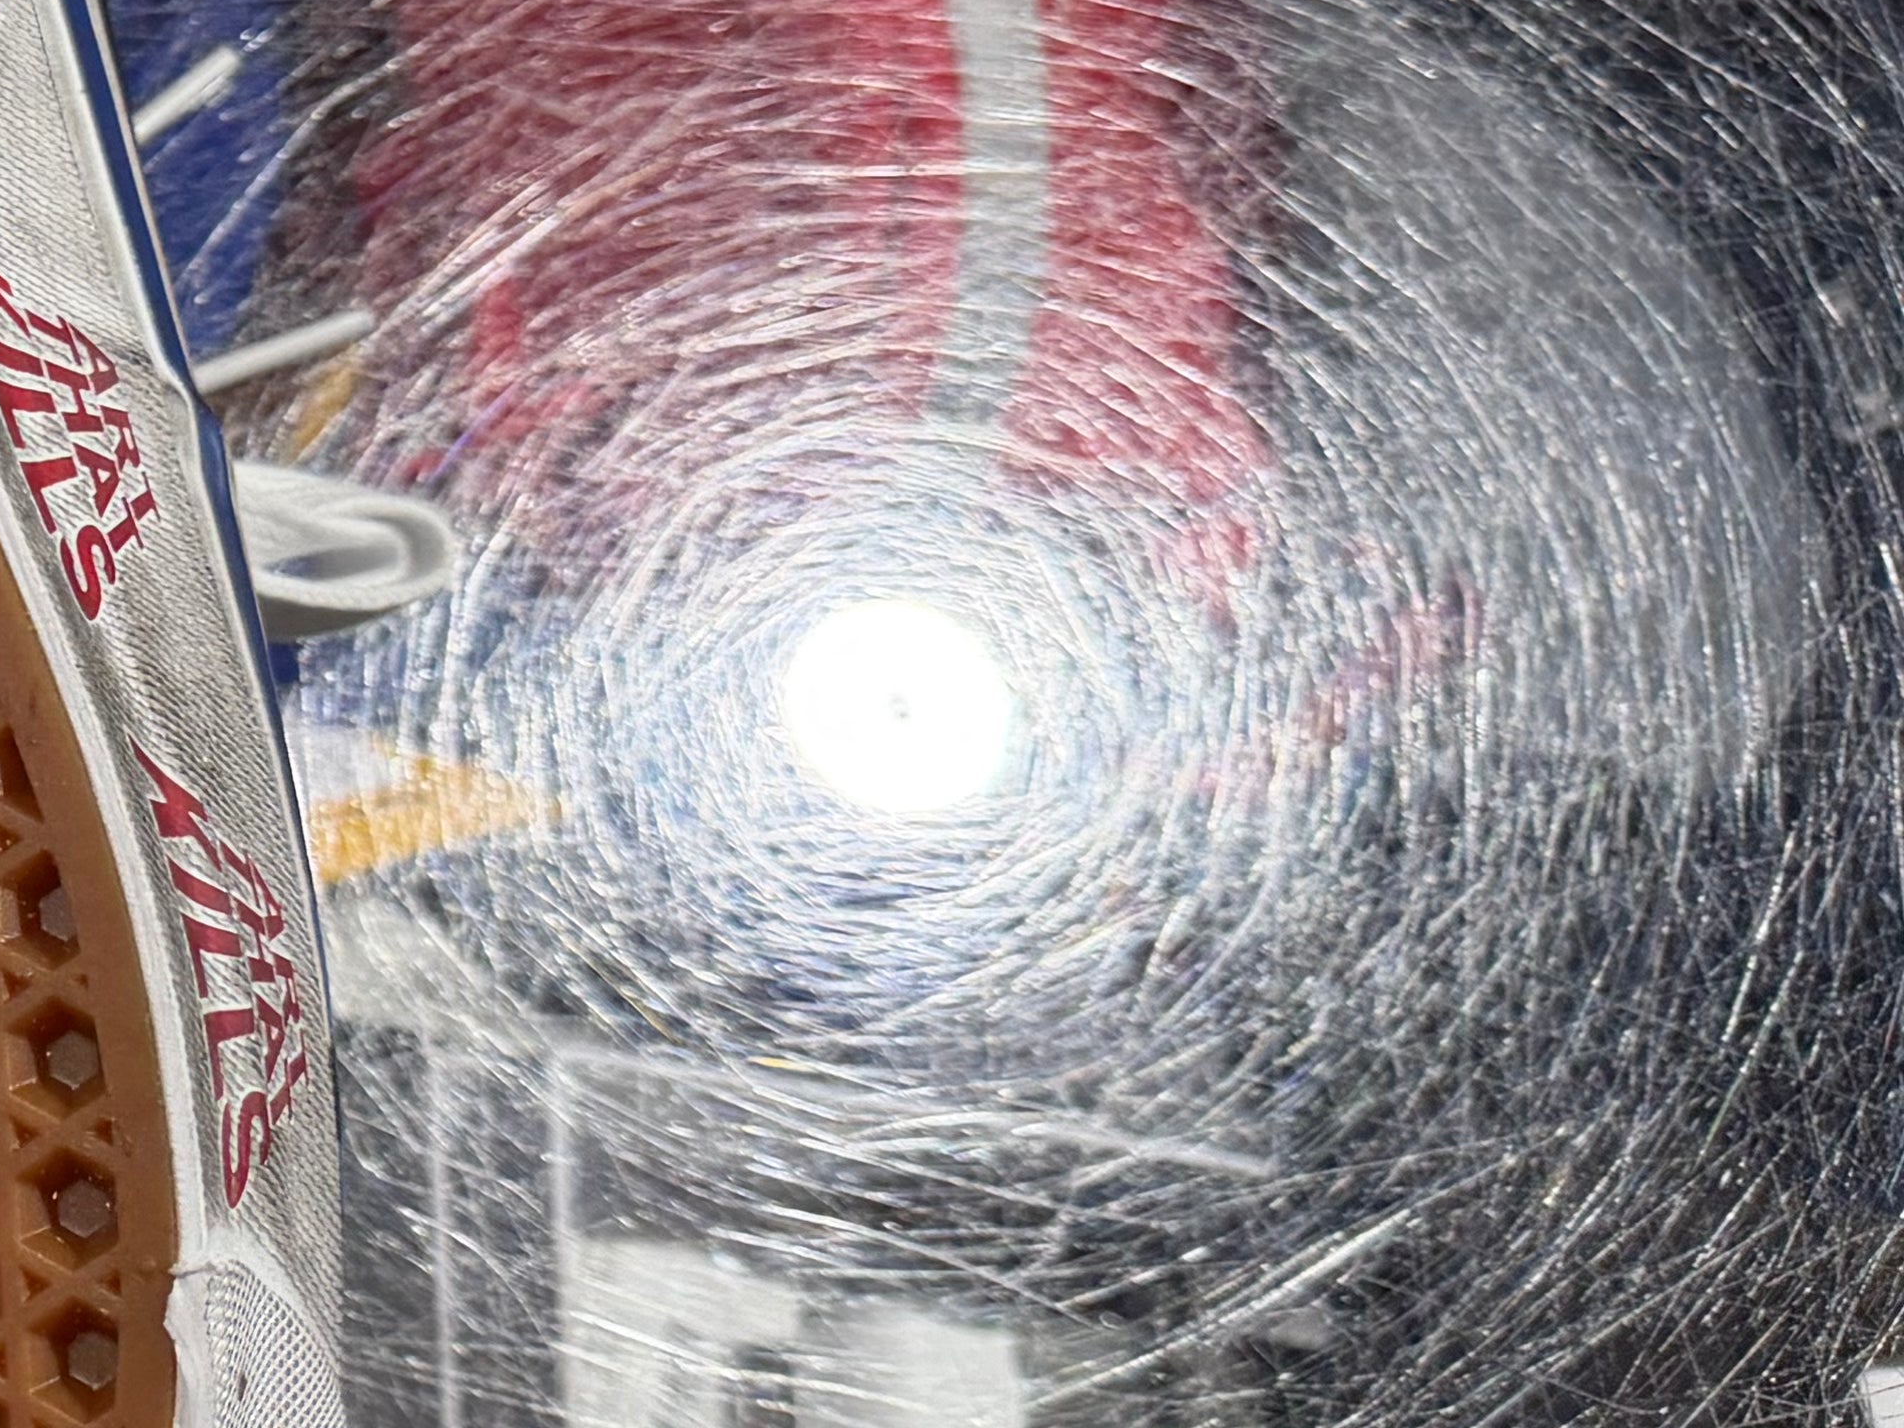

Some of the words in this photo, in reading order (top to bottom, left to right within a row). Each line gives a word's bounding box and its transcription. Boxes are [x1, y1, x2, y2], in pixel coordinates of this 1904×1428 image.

[24, 308, 145, 553] THAT
[67, 317, 161, 521] ART
[128, 735, 271, 1209] KILLS
[220, 840, 293, 1125] THAT
[247, 851, 309, 1085] ART
